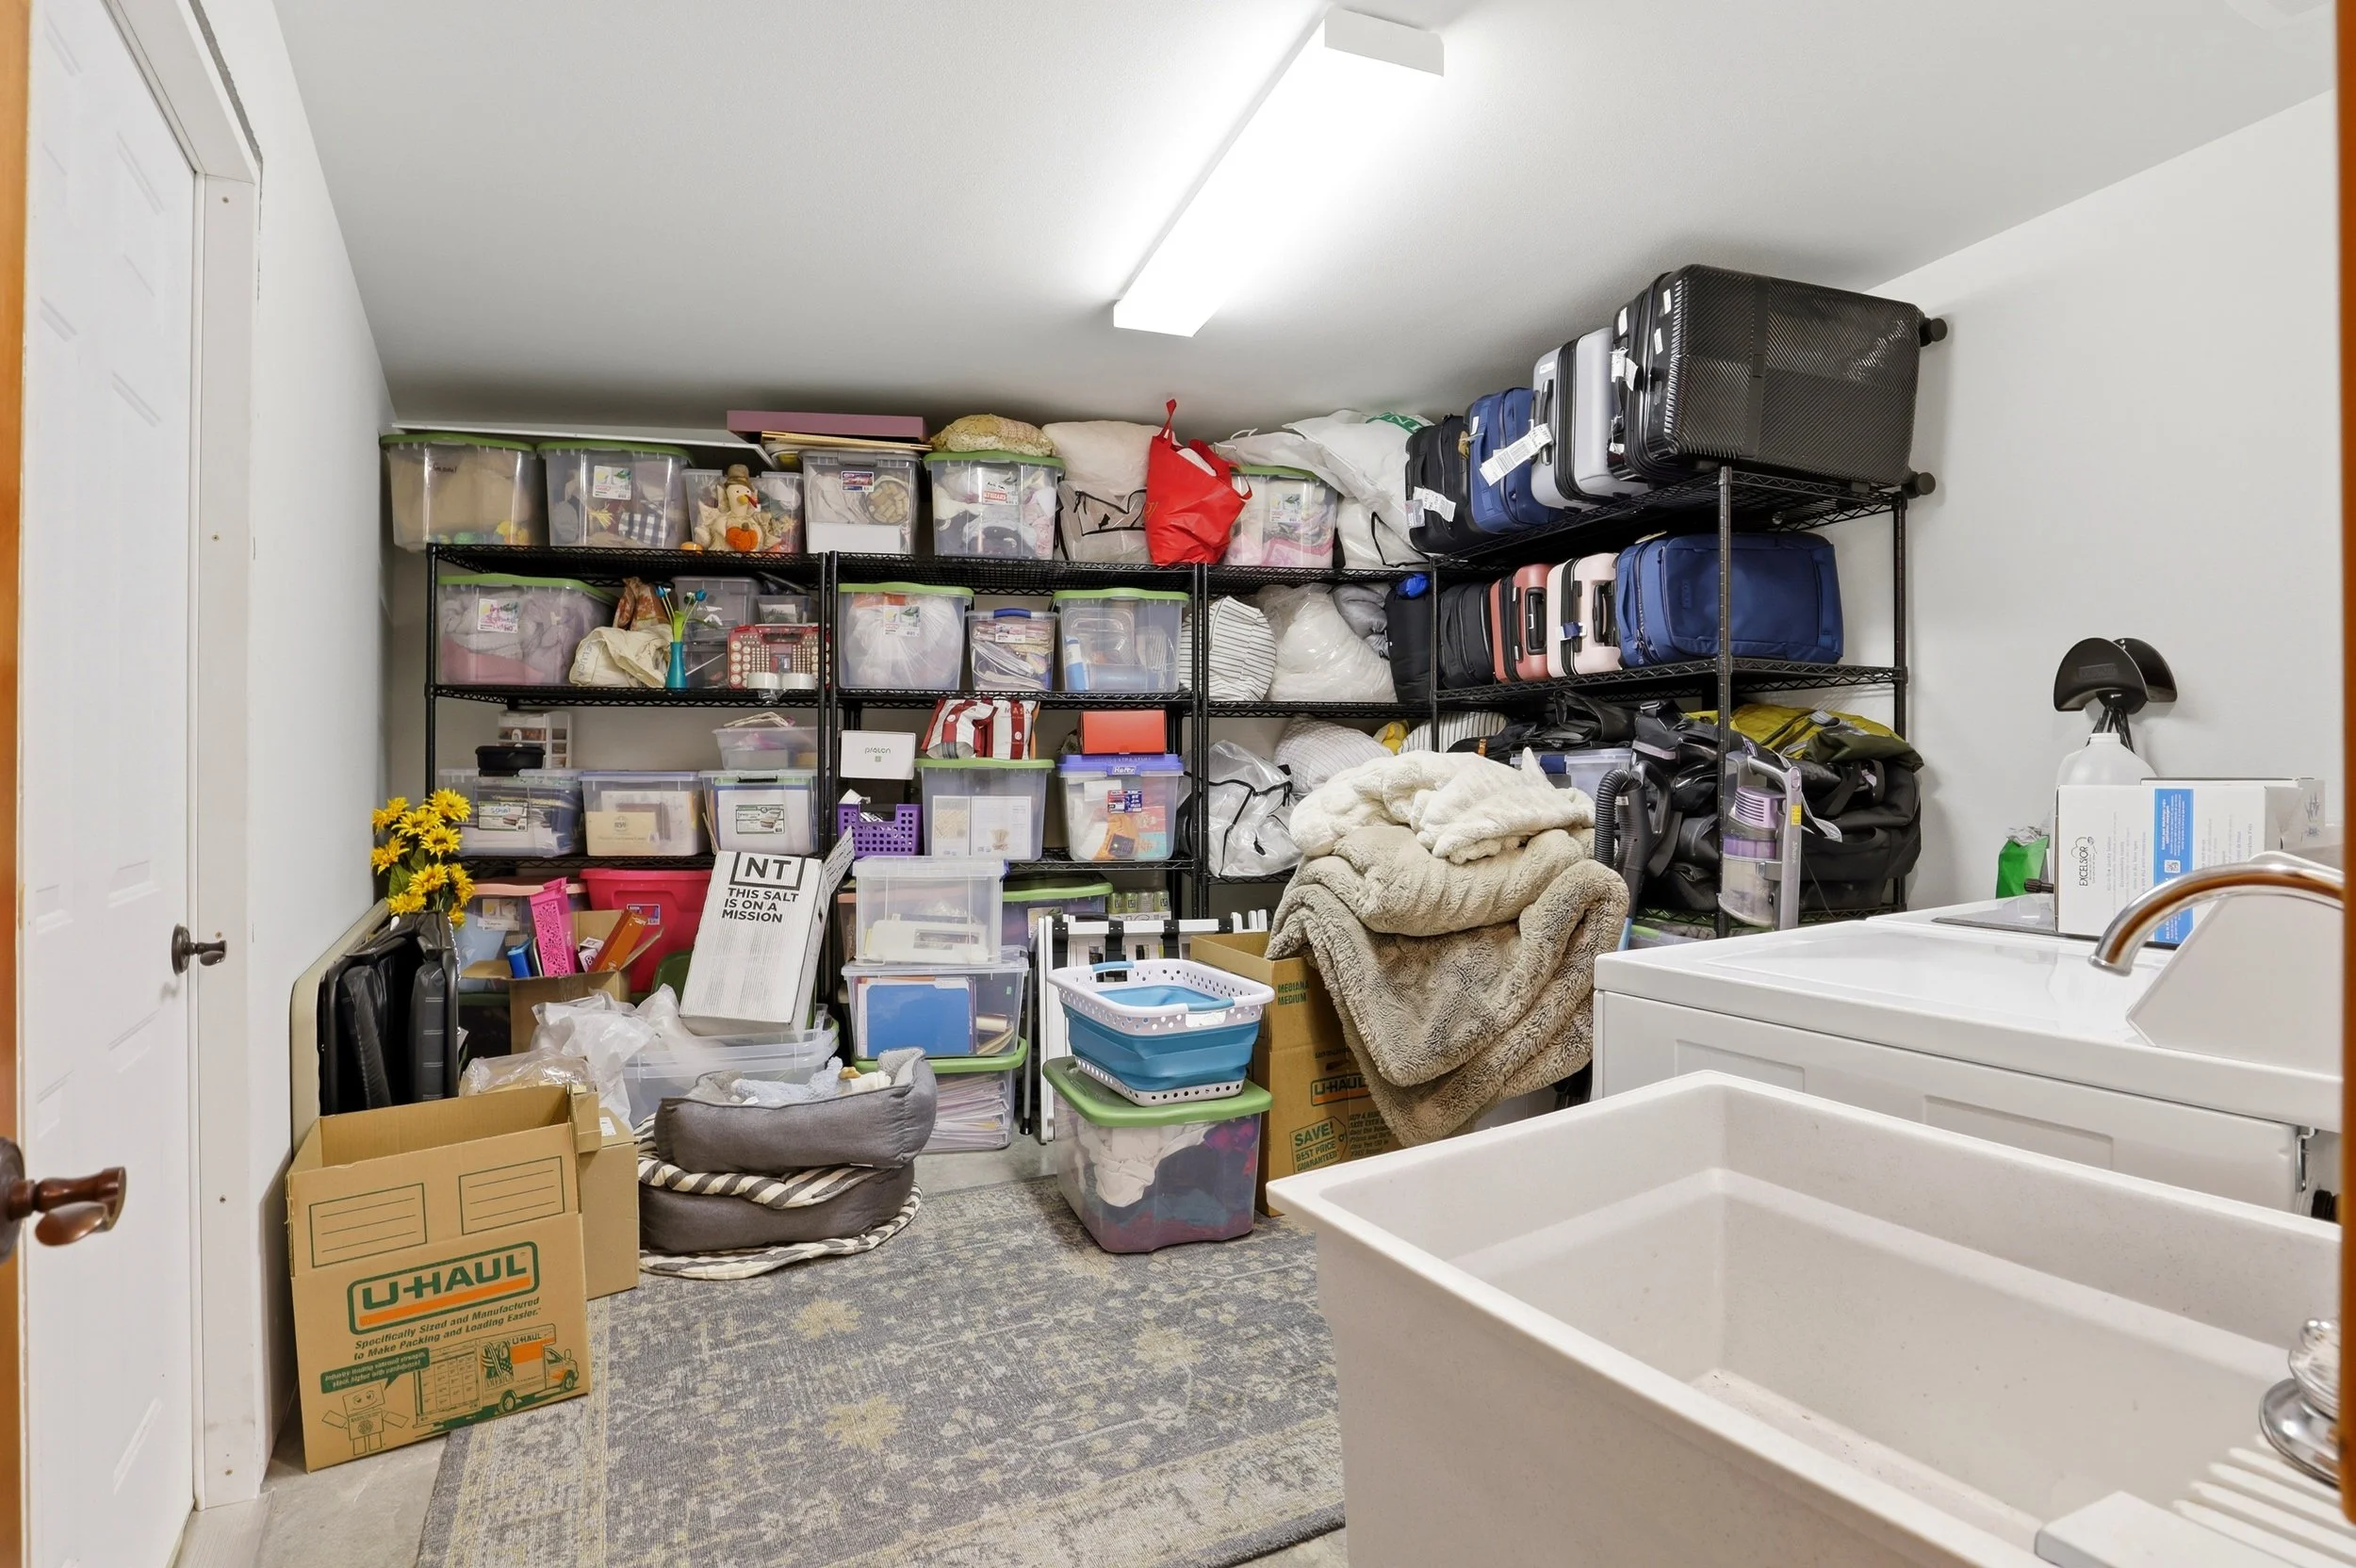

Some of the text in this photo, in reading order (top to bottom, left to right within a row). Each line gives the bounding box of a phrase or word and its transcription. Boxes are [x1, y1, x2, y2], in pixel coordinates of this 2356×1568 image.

[744, 857, 792, 880] NT
[724, 898, 777, 911] IS ON A
[728, 888, 799, 903] THIS SALT
[722, 909, 783, 923] MISSION
[1278, 992, 1307, 1005] MEDIUM
[1314, 1076, 1365, 1095] U-HAUL
[1295, 1120, 1334, 1147] SAVE!
[1296, 1148, 1314, 1162] BEST
[1315, 1140, 1335, 1154] PRICE
[1297, 1151, 1337, 1171] GUARANTEED
[362, 1254, 527, 1310] U-HAUL
[354, 1297, 540, 1349] Specifically Sized and Manufactured
[353, 1352, 364, 1361] to
[367, 1343, 396, 1358] Make
[400, 1333, 440, 1349] Packing
[443, 1328, 462, 1339] and
[466, 1318, 504, 1333] Loading
